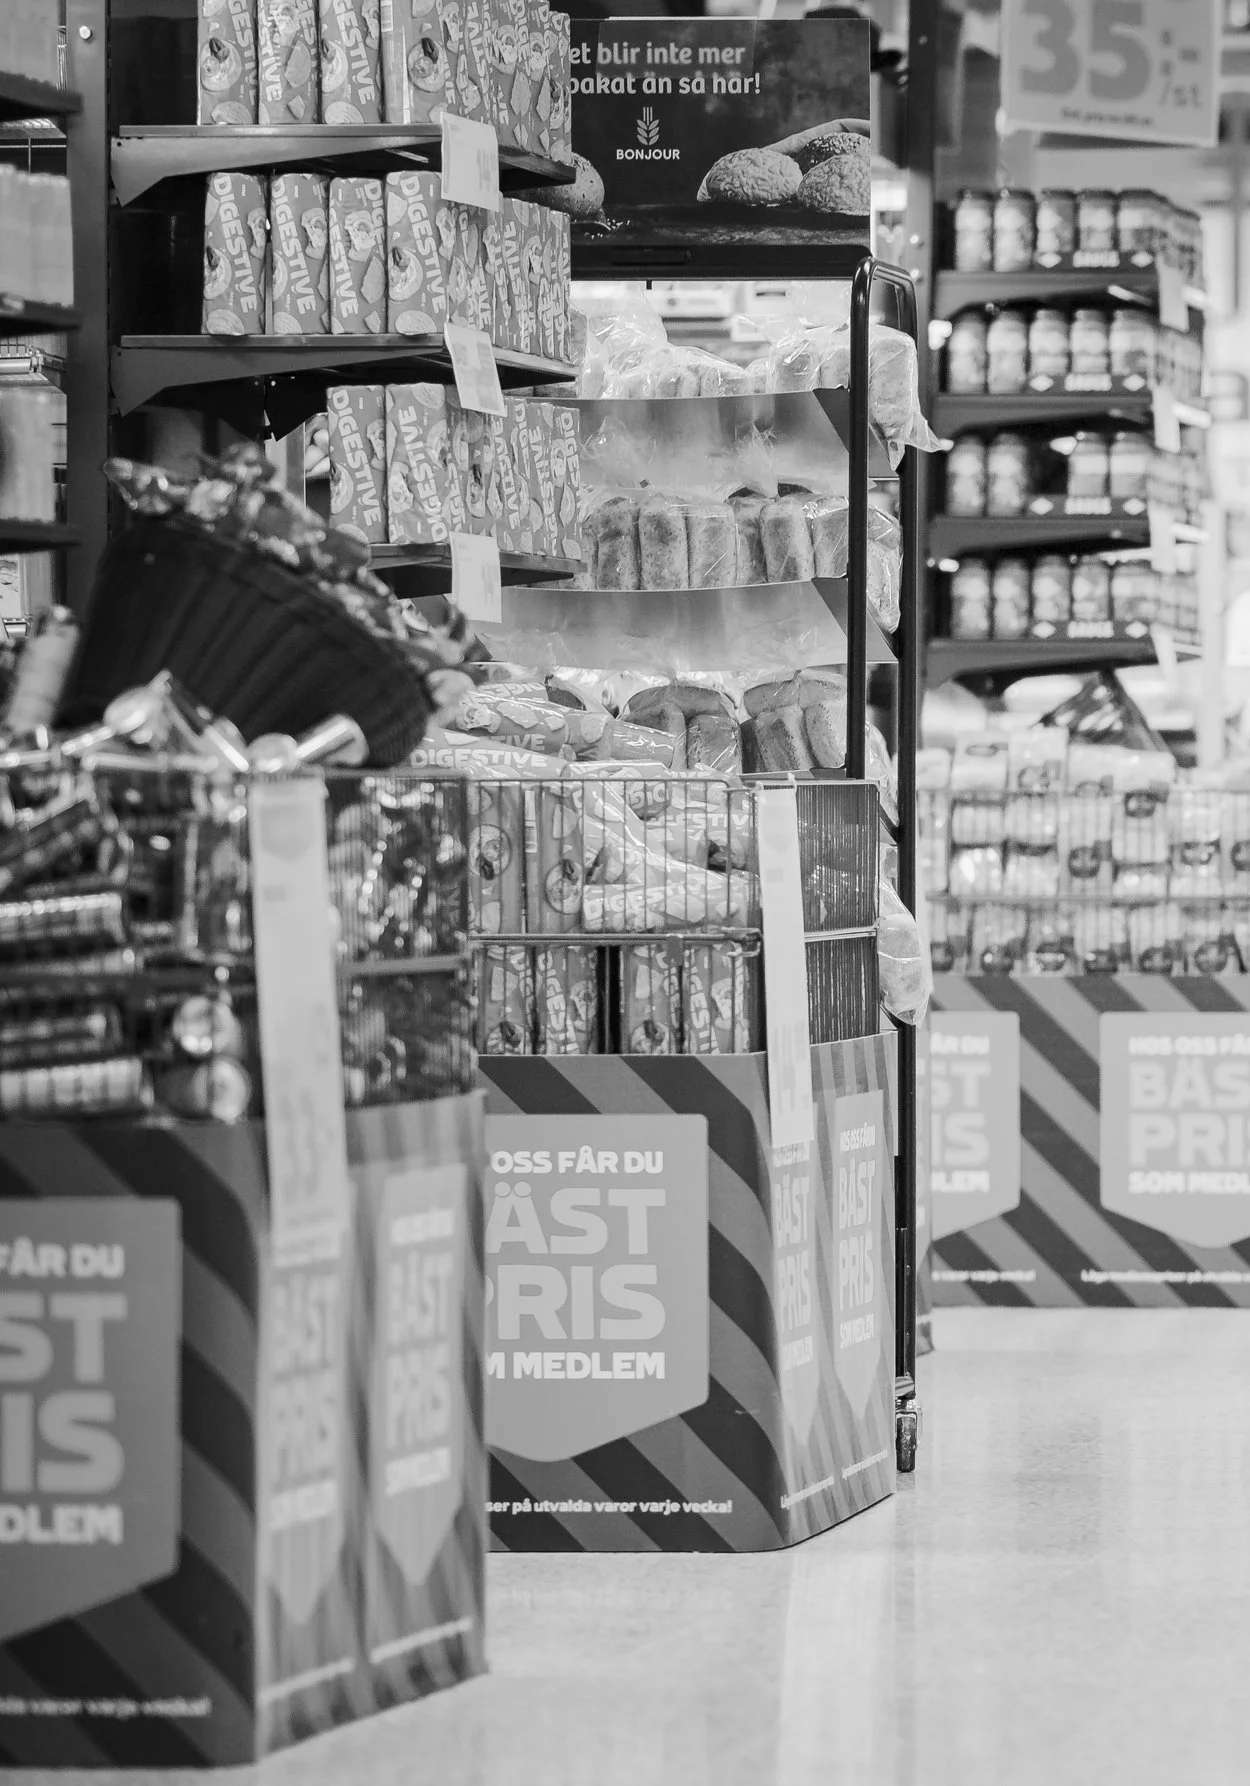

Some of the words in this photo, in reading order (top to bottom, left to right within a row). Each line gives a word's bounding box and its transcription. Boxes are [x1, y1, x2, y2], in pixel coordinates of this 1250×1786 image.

[598, 42, 641, 65] blir
[646, 42, 692, 65] inte
[698, 47, 746, 65] mer
[642, 71, 672, 95] än
[679, 70, 706, 95] så
[712, 71, 761, 95] här!
[616, 149, 680, 161] BONJOUR
[213, 175, 258, 313] DIGESTIVE
[270, 177, 317, 315] DIGESTIVE
[399, 174, 447, 314] DIGESTIVE
[331, 388, 382, 528] DIGESTIVE
[397, 405, 449, 543] DIGESTIVE
[410, 749, 548, 769] DIGESTIVE
[491, 1150, 553, 1174] OSS
[558, 1144, 619, 1174] FÅR
[623, 1150, 664, 1174] DU
[839, 1156, 876, 1230] BÄST
[485, 1181, 667, 1255] ÄST
[69, 1243, 126, 1278] DU
[839, 1229, 874, 1312] PRIS
[485, 1264, 667, 1340] RIS
[513, 1351, 666, 1380] MEDLEM
[2, 1390, 125, 1492] IS
[512, 1498, 531, 1515] på
[533, 1498, 593, 1513] utvalda
[593, 1501, 638, 1513] varor
[639, 1499, 681, 1516] varje
[682, 1499, 733, 1514] vecka!
